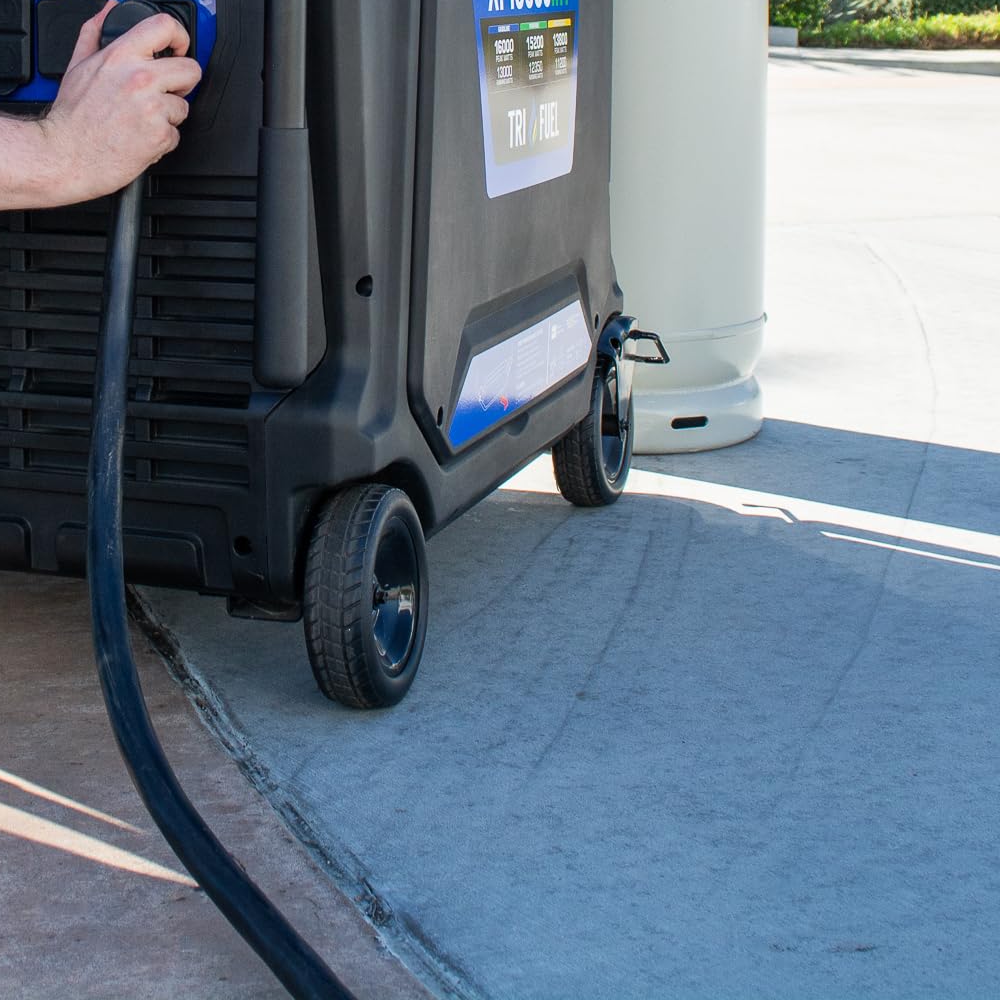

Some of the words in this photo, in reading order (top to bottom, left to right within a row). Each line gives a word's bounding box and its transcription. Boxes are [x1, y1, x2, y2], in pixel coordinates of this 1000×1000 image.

[494, 38, 514, 55] 16000
[526, 35, 544, 51] 15200
[496, 65, 513, 79] 13000
[507, 108, 526, 149] TRI
[539, 101, 560, 141] FUEL
